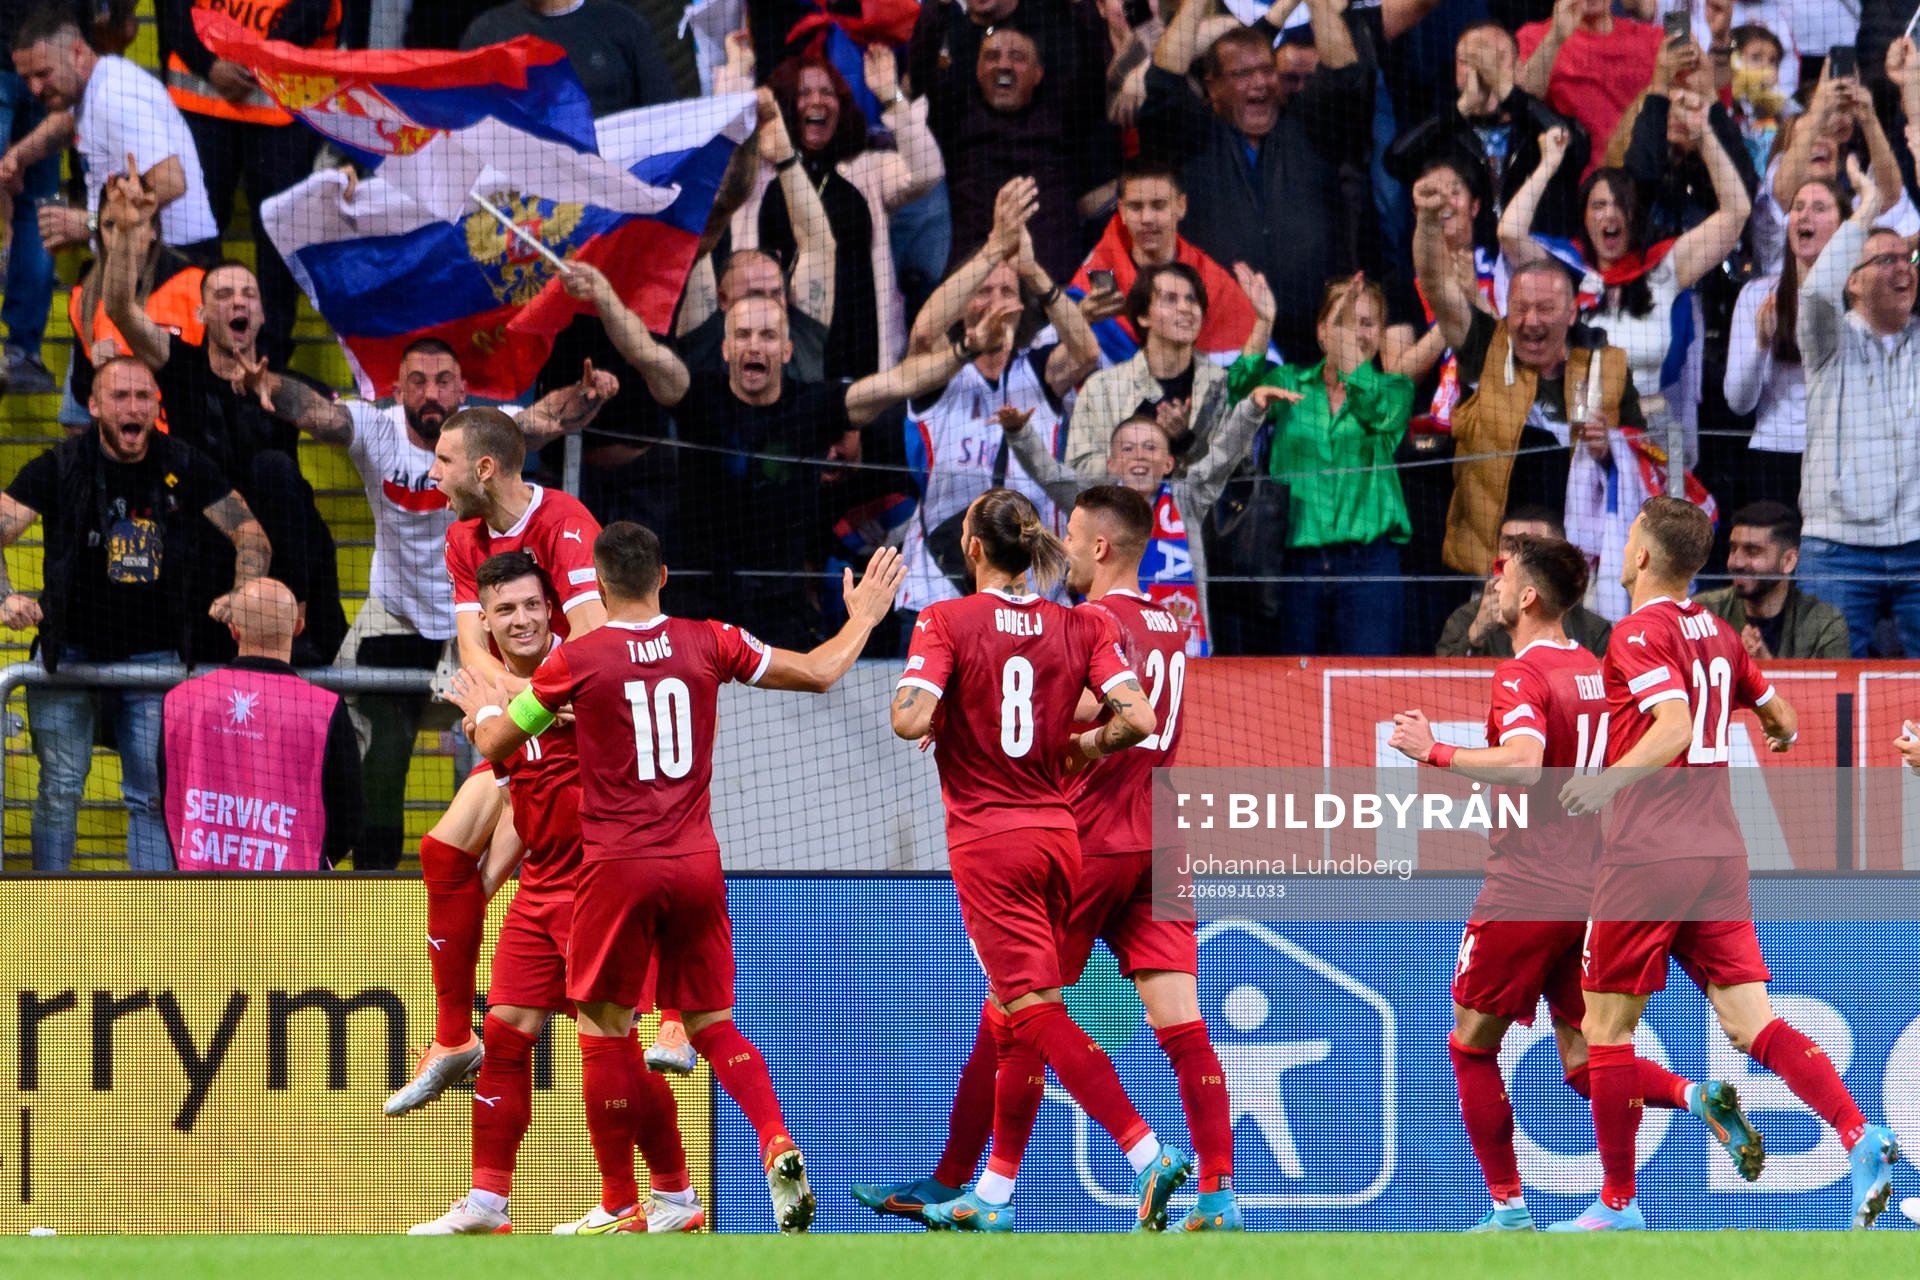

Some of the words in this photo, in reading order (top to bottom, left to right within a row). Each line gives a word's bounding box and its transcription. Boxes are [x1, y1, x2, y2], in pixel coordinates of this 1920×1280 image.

[994, 608, 1043, 636] GUDELJ
[626, 631, 673, 663] TADIĆ
[1001, 656, 1034, 758] 8
[1134, 649, 1186, 751] 20
[1687, 657, 1731, 764] 22
[624, 677, 693, 781] 10
[185, 788, 298, 839] SERVICE
[190, 828, 289, 871] SAFETY
[728, 1052, 751, 1067] FSS
[1201, 1076, 1222, 1085] FSS
[605, 1099, 627, 1109] FSS
[1498, 993, 1920, 1194] OB
